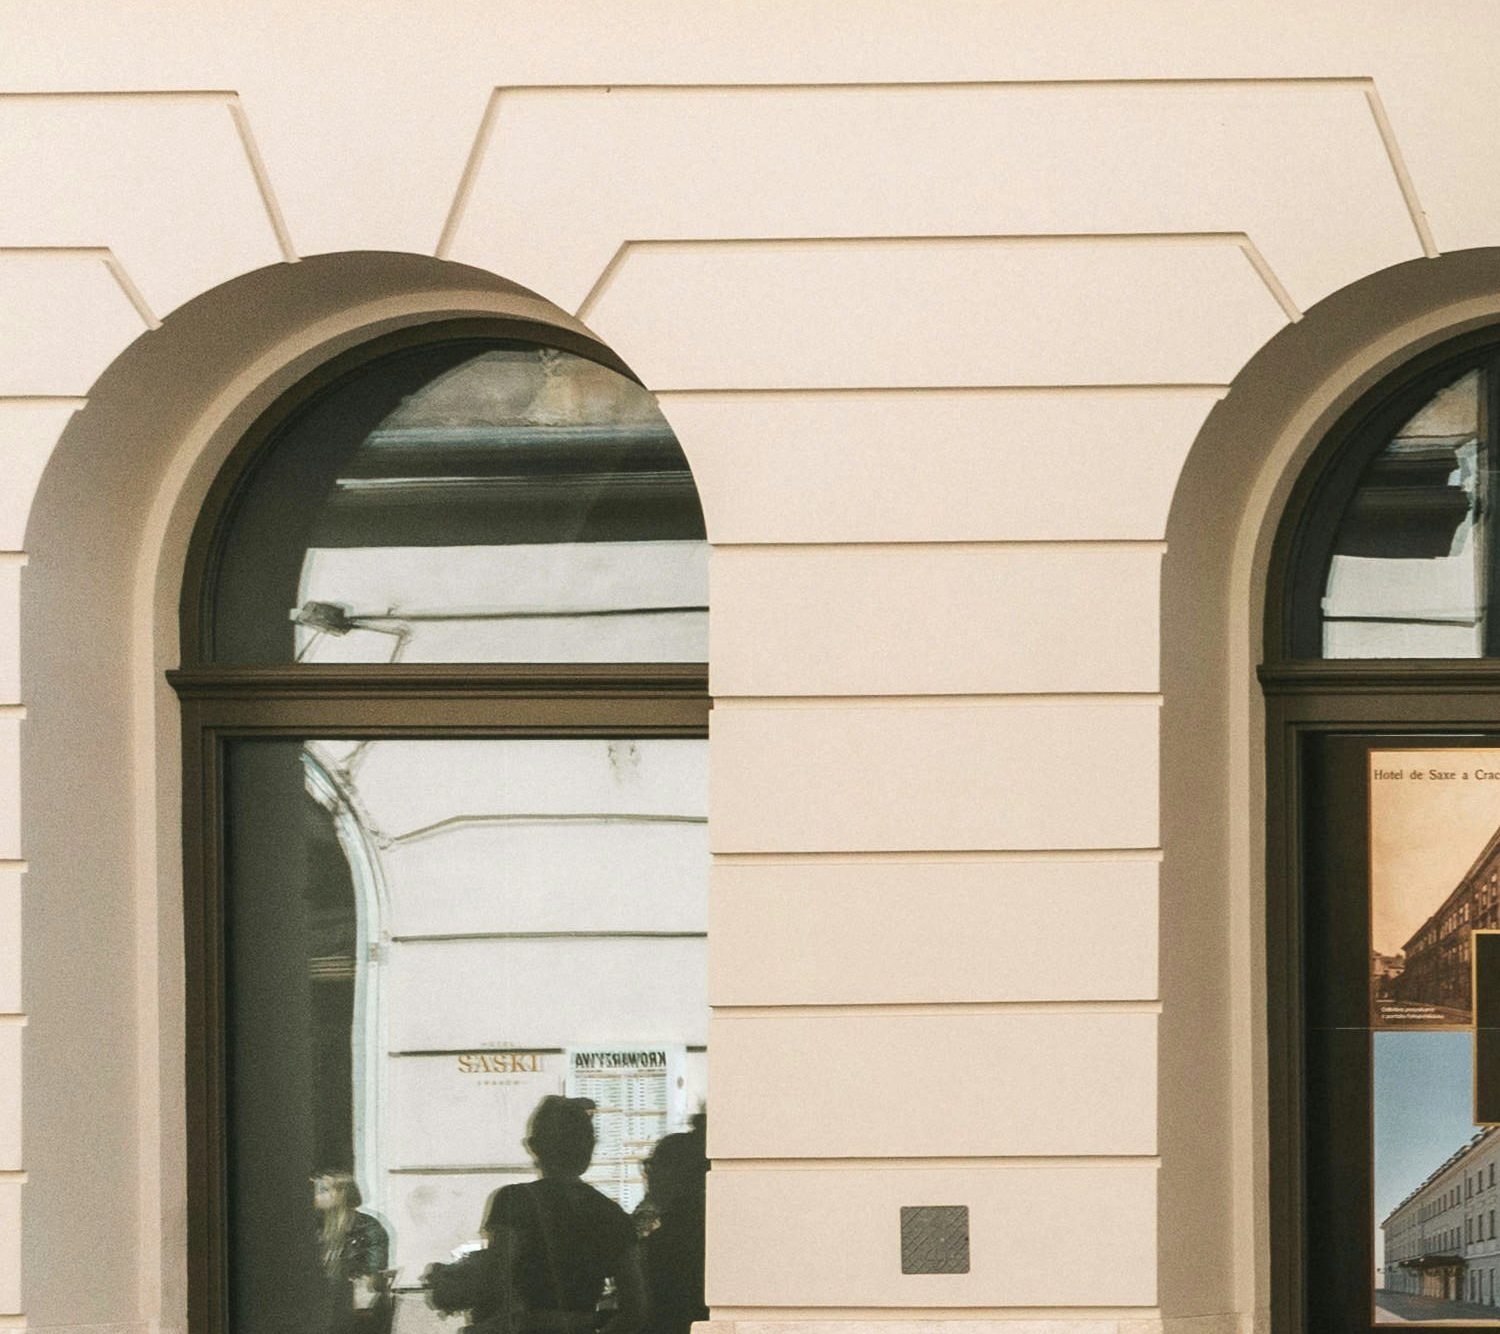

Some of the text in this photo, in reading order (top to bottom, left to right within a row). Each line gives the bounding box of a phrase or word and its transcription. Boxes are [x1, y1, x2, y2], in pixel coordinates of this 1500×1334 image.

[1373, 769, 1403, 780] Hotel
[1409, 770, 1424, 780] de
[1429, 769, 1456, 781] Saxe
[1461, 771, 1469, 780] a
[457, 1052, 539, 1073] SASKI
